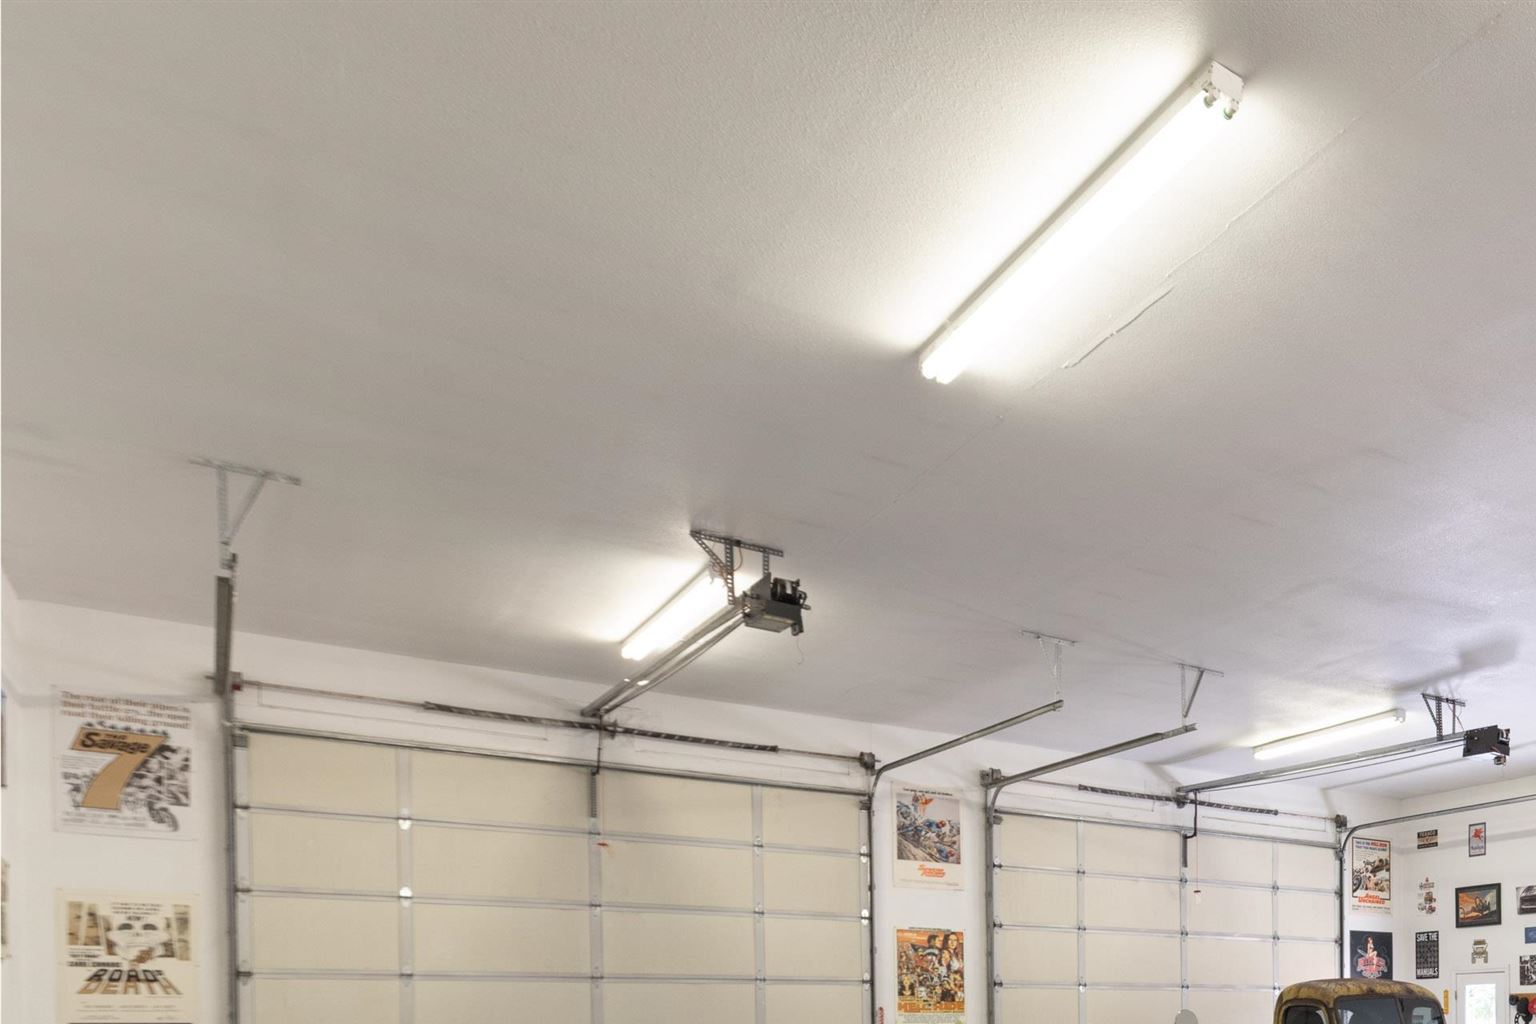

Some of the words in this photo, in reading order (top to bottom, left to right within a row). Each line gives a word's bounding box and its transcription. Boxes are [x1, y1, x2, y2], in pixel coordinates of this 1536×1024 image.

[80, 731, 151, 754] Savage
[1416, 932, 1428, 942] SAVE
[1429, 931, 1438, 941] THE
[84, 968, 161, 982] ROAD
[1416, 967, 1439, 977] MANUALS
[76, 977, 183, 995] DEATH
